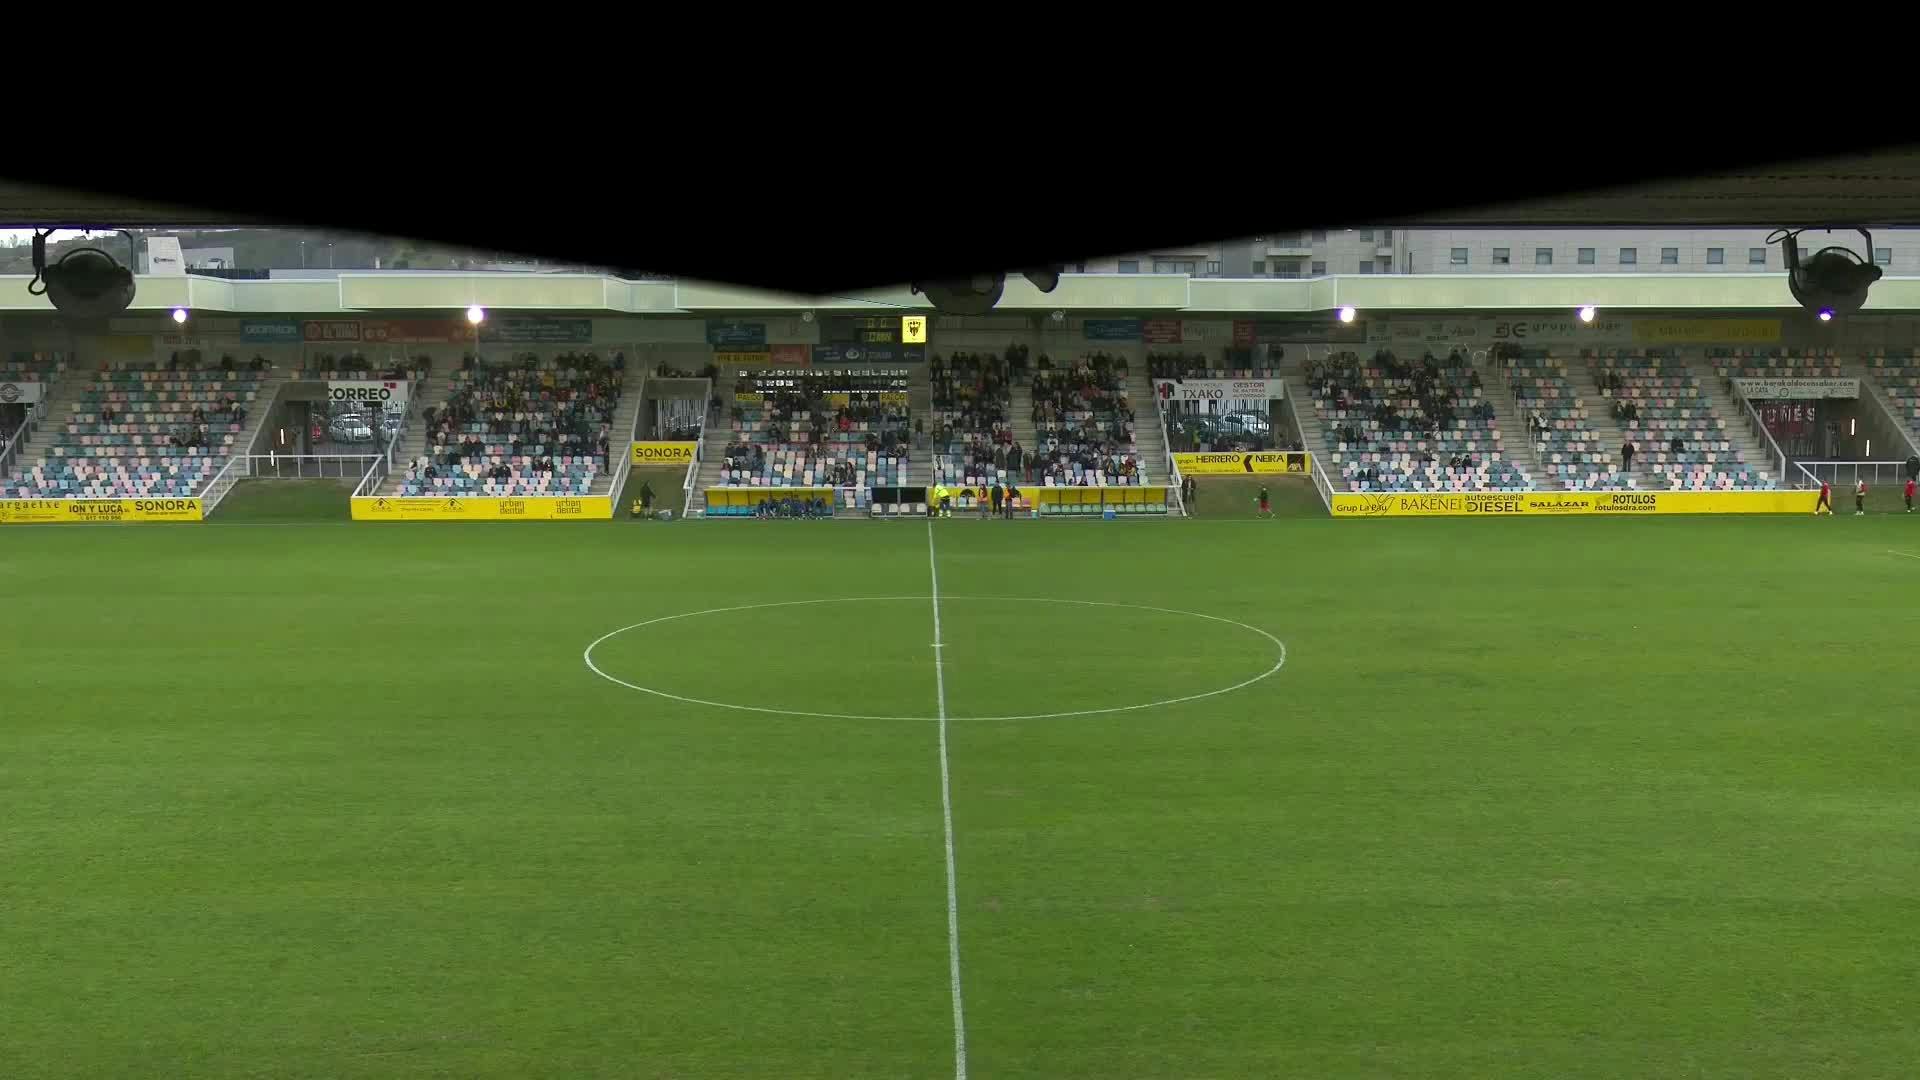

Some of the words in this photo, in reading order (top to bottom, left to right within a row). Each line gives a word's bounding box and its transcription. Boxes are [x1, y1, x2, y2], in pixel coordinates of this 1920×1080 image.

[1182, 389, 1224, 399] TXAKO
[635, 448, 692, 457] SONORA
[1196, 454, 1240, 463] HERRERO
[499, 499, 525, 508] urban
[556, 498, 581, 507] urban
[1612, 494, 1656, 504] ROTULOS
[69, 505, 86, 513] ION
[88, 505, 95, 513] Y
[98, 505, 124, 513] LUCA
[135, 500, 197, 511] SONORA
[556, 506, 582, 514] dental
[1336, 504, 1358, 513] Grup
[1466, 501, 1524, 512] DIESEL
[499, 506, 525, 515] dental
